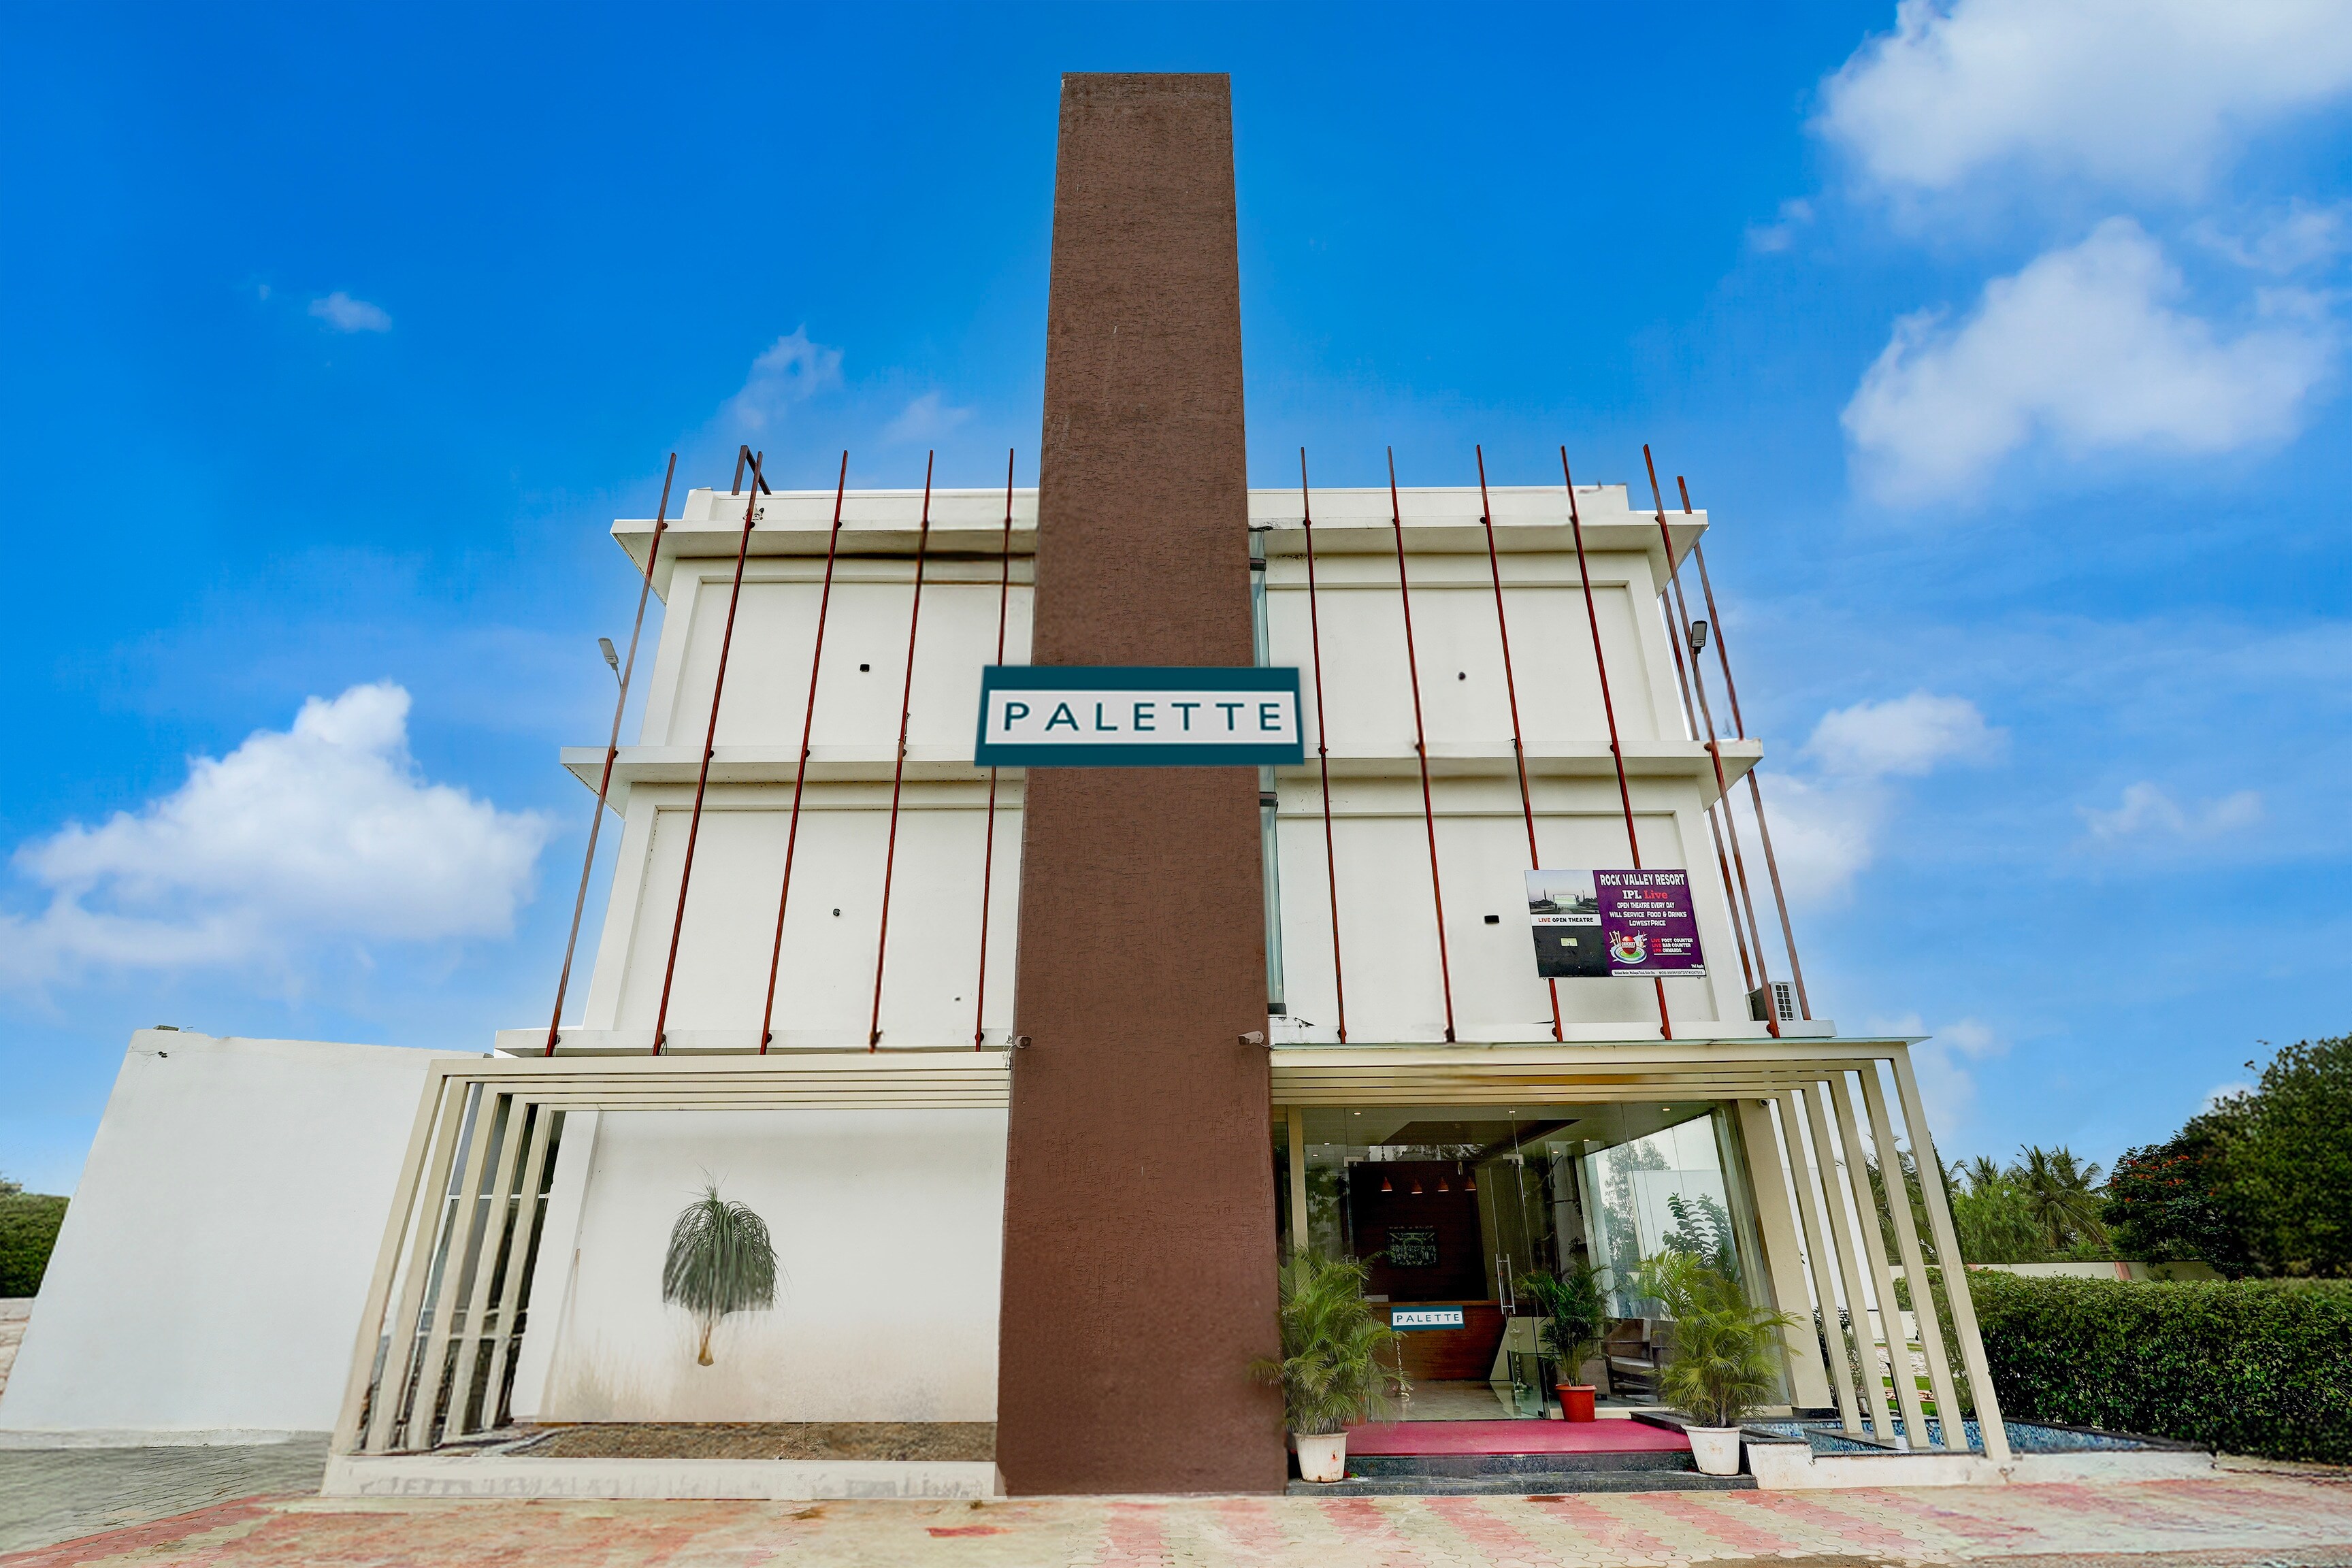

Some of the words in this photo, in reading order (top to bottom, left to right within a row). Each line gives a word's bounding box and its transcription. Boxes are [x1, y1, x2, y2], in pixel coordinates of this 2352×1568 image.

[1004, 702, 1281, 731] PALETTE
[1599, 874, 1621, 885] ROCK
[1622, 874, 1653, 885] VALLEY
[1655, 874, 1684, 885] RESORT
[1622, 890, 1642, 899] IPL
[1644, 890, 1668, 899] Live
[1396, 1314, 1460, 1322] PALETTE
